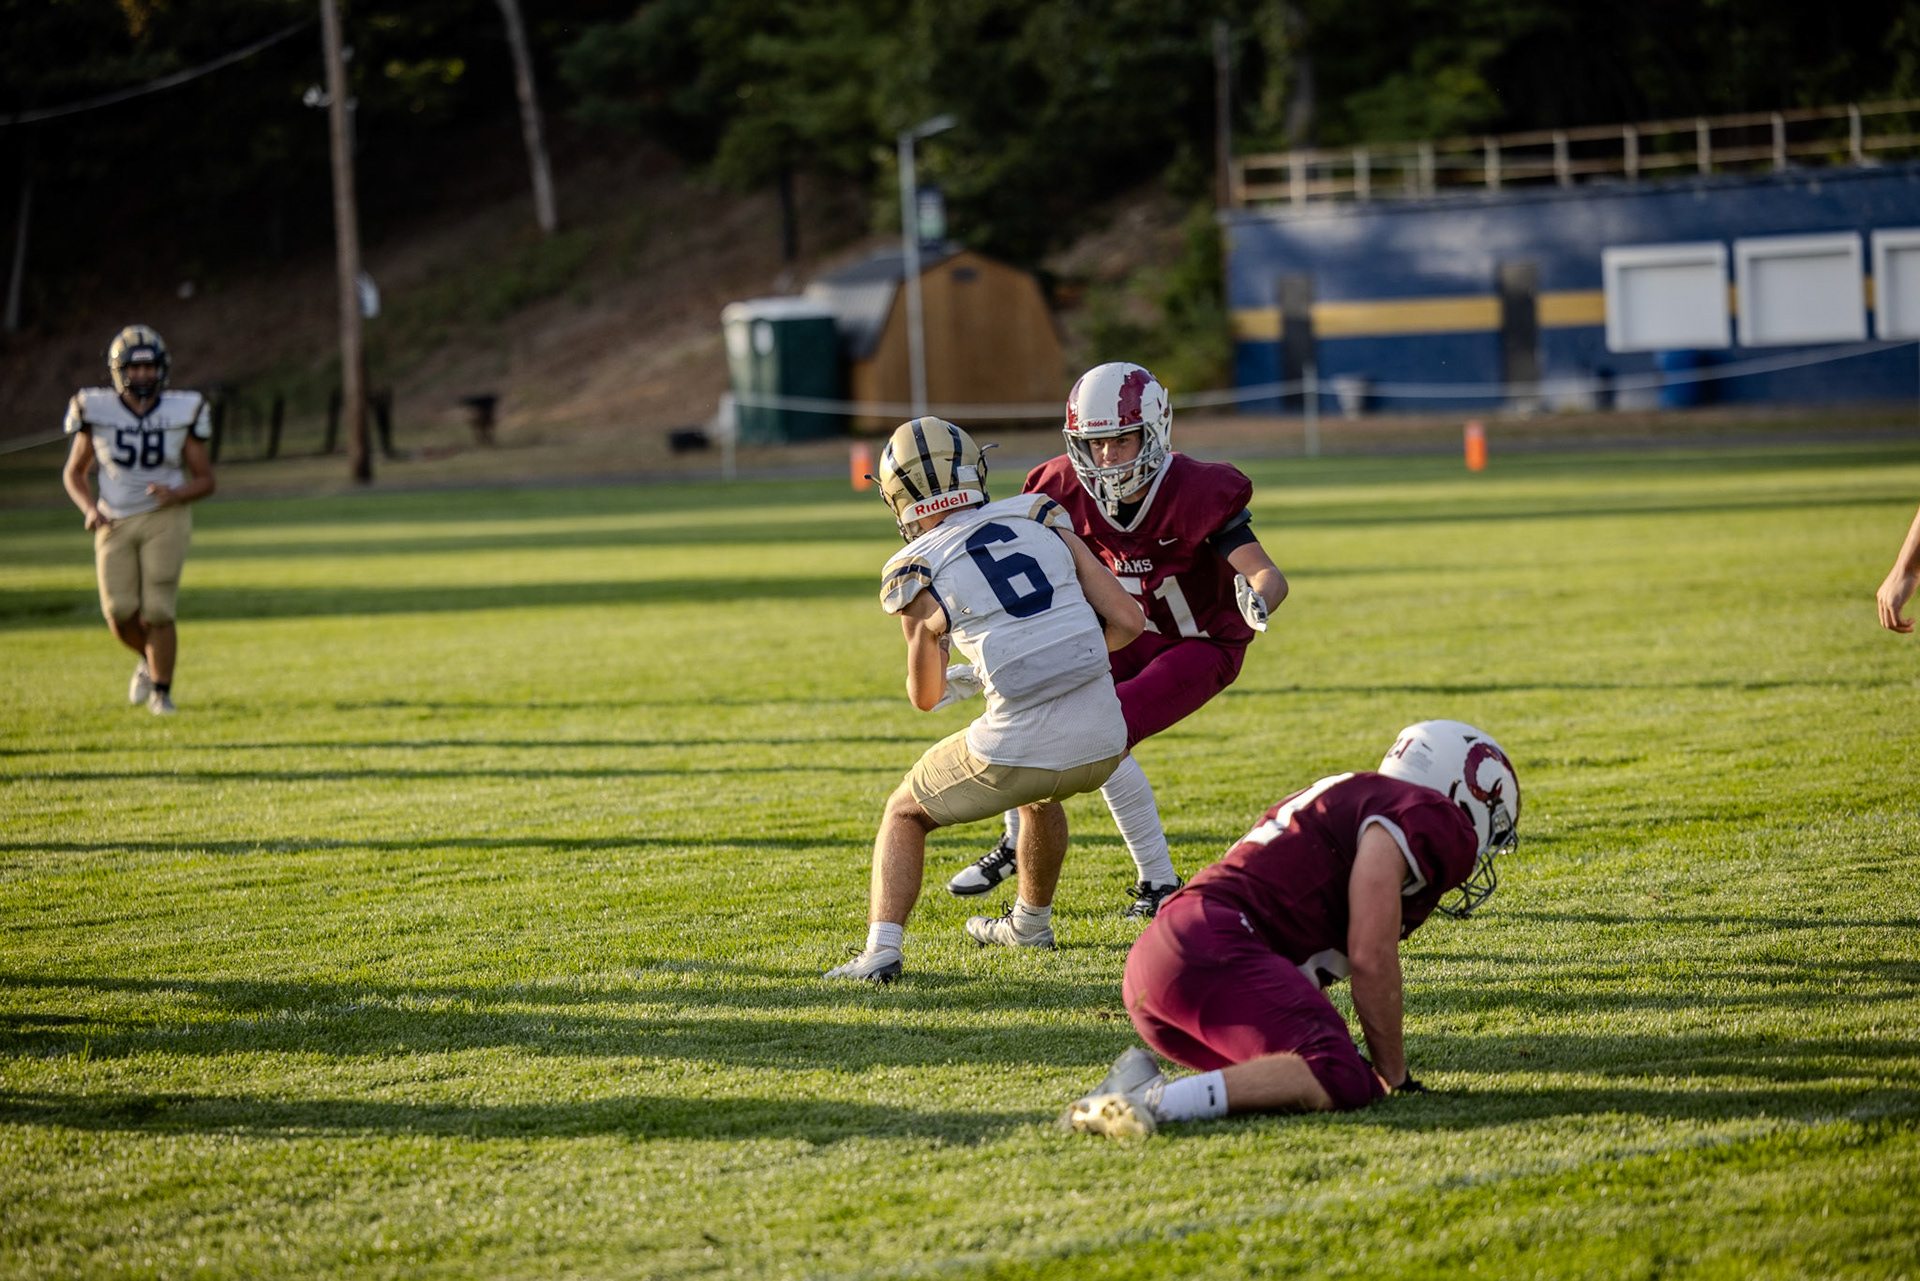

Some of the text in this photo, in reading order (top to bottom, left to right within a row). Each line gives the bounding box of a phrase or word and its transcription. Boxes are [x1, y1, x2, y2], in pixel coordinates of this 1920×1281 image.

[1087, 419, 1108, 427] Riddell
[112, 428, 165, 470] 58
[914, 491, 969, 516] Riddell
[965, 521, 1055, 619] 6
[1113, 558, 1153, 574] RAMS
